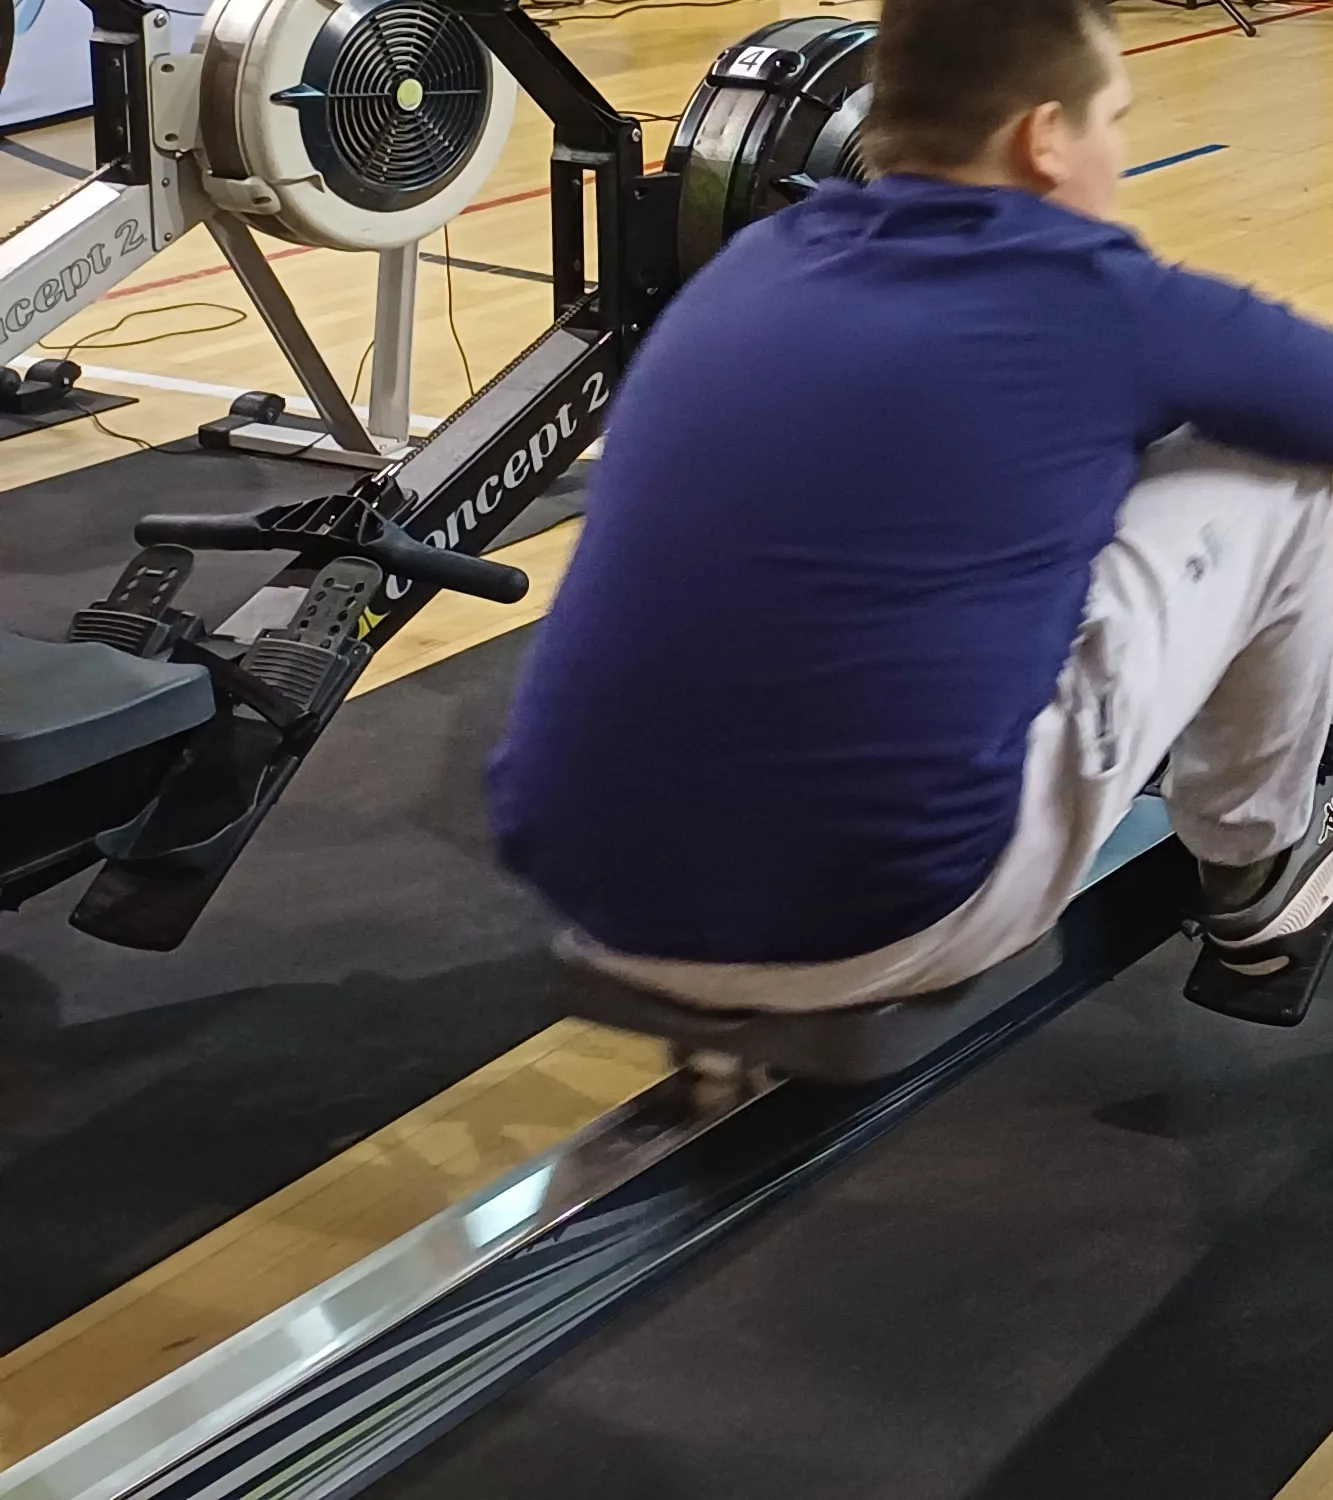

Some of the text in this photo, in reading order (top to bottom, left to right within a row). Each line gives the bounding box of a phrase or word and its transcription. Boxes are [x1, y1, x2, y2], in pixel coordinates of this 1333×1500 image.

[737, 46, 764, 74] 4
[0, 218, 145, 342] cept 2
[581, 371, 610, 414] 2
